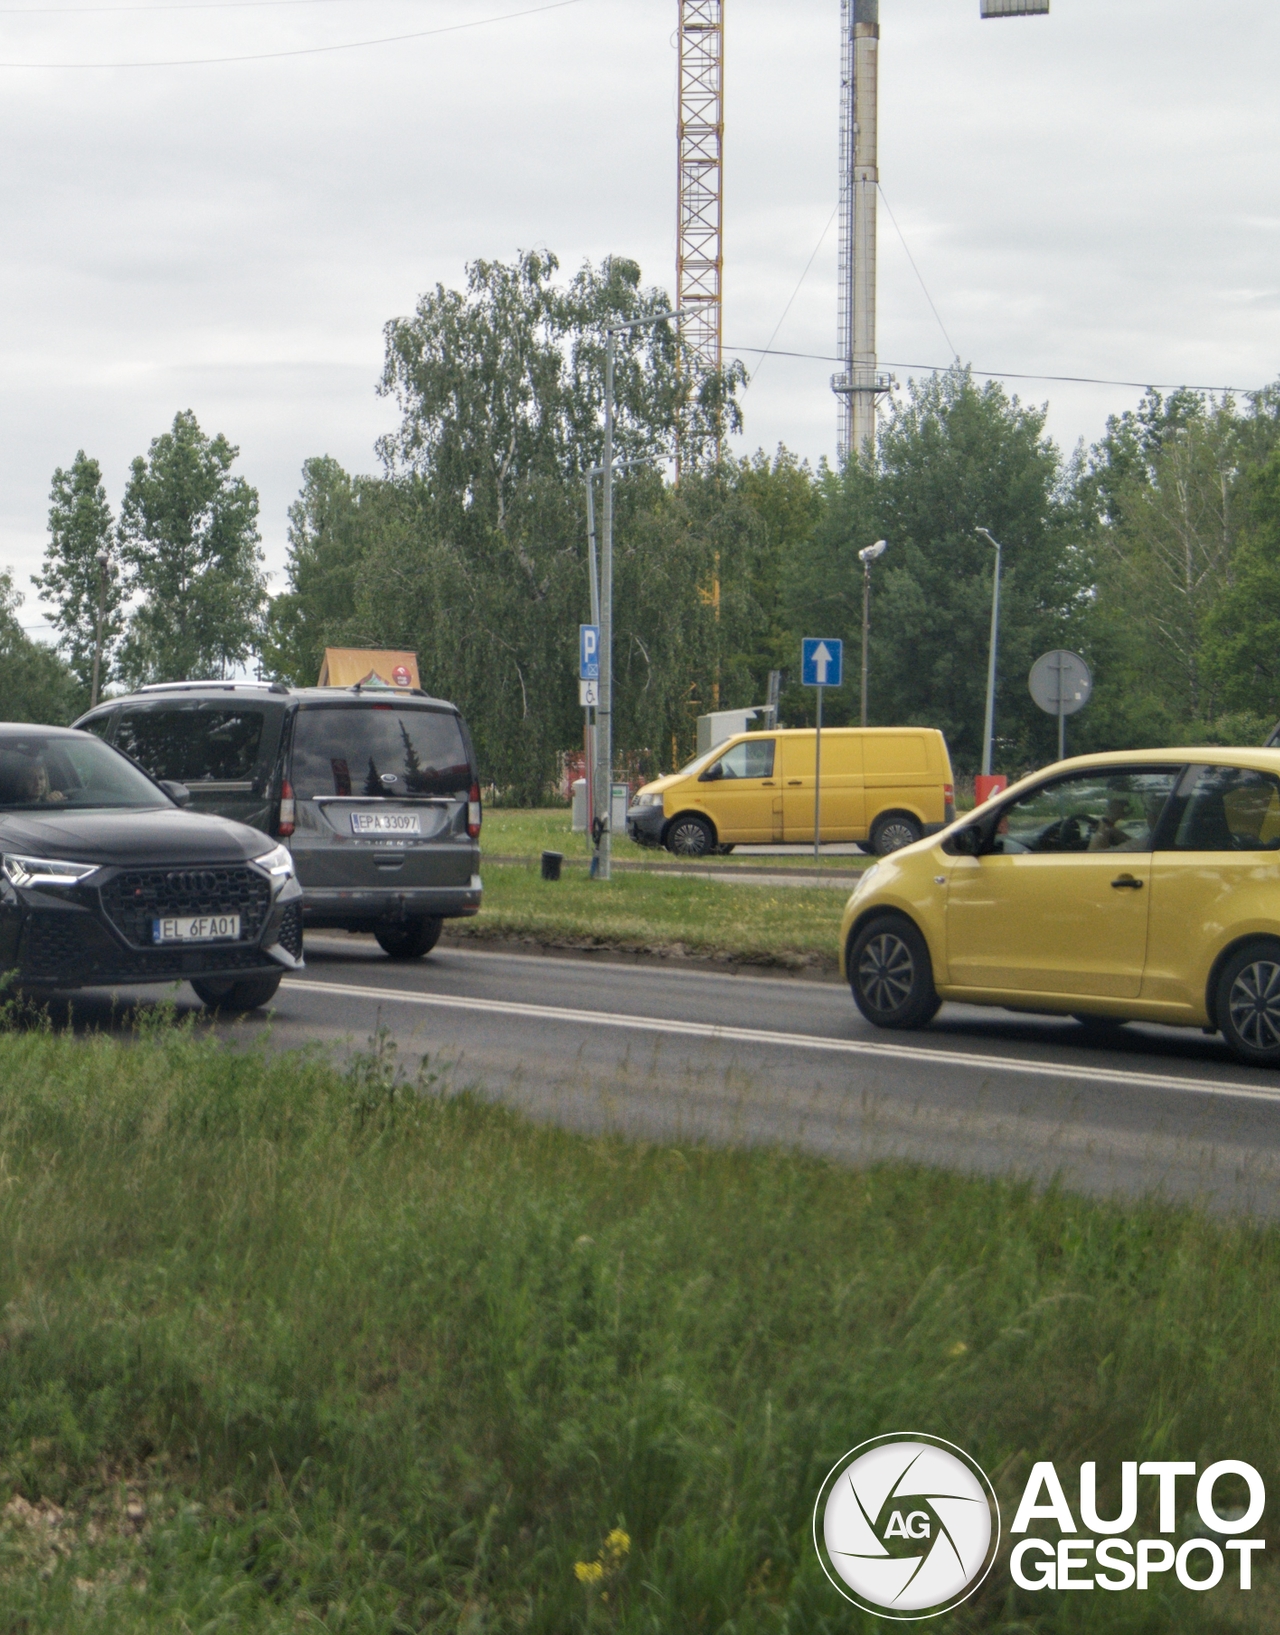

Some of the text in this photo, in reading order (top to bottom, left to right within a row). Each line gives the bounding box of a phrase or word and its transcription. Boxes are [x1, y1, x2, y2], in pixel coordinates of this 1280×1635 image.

[584, 630, 596, 663] P
[359, 815, 416, 829] EPA 33097
[163, 917, 236, 938] EL 6FA01
